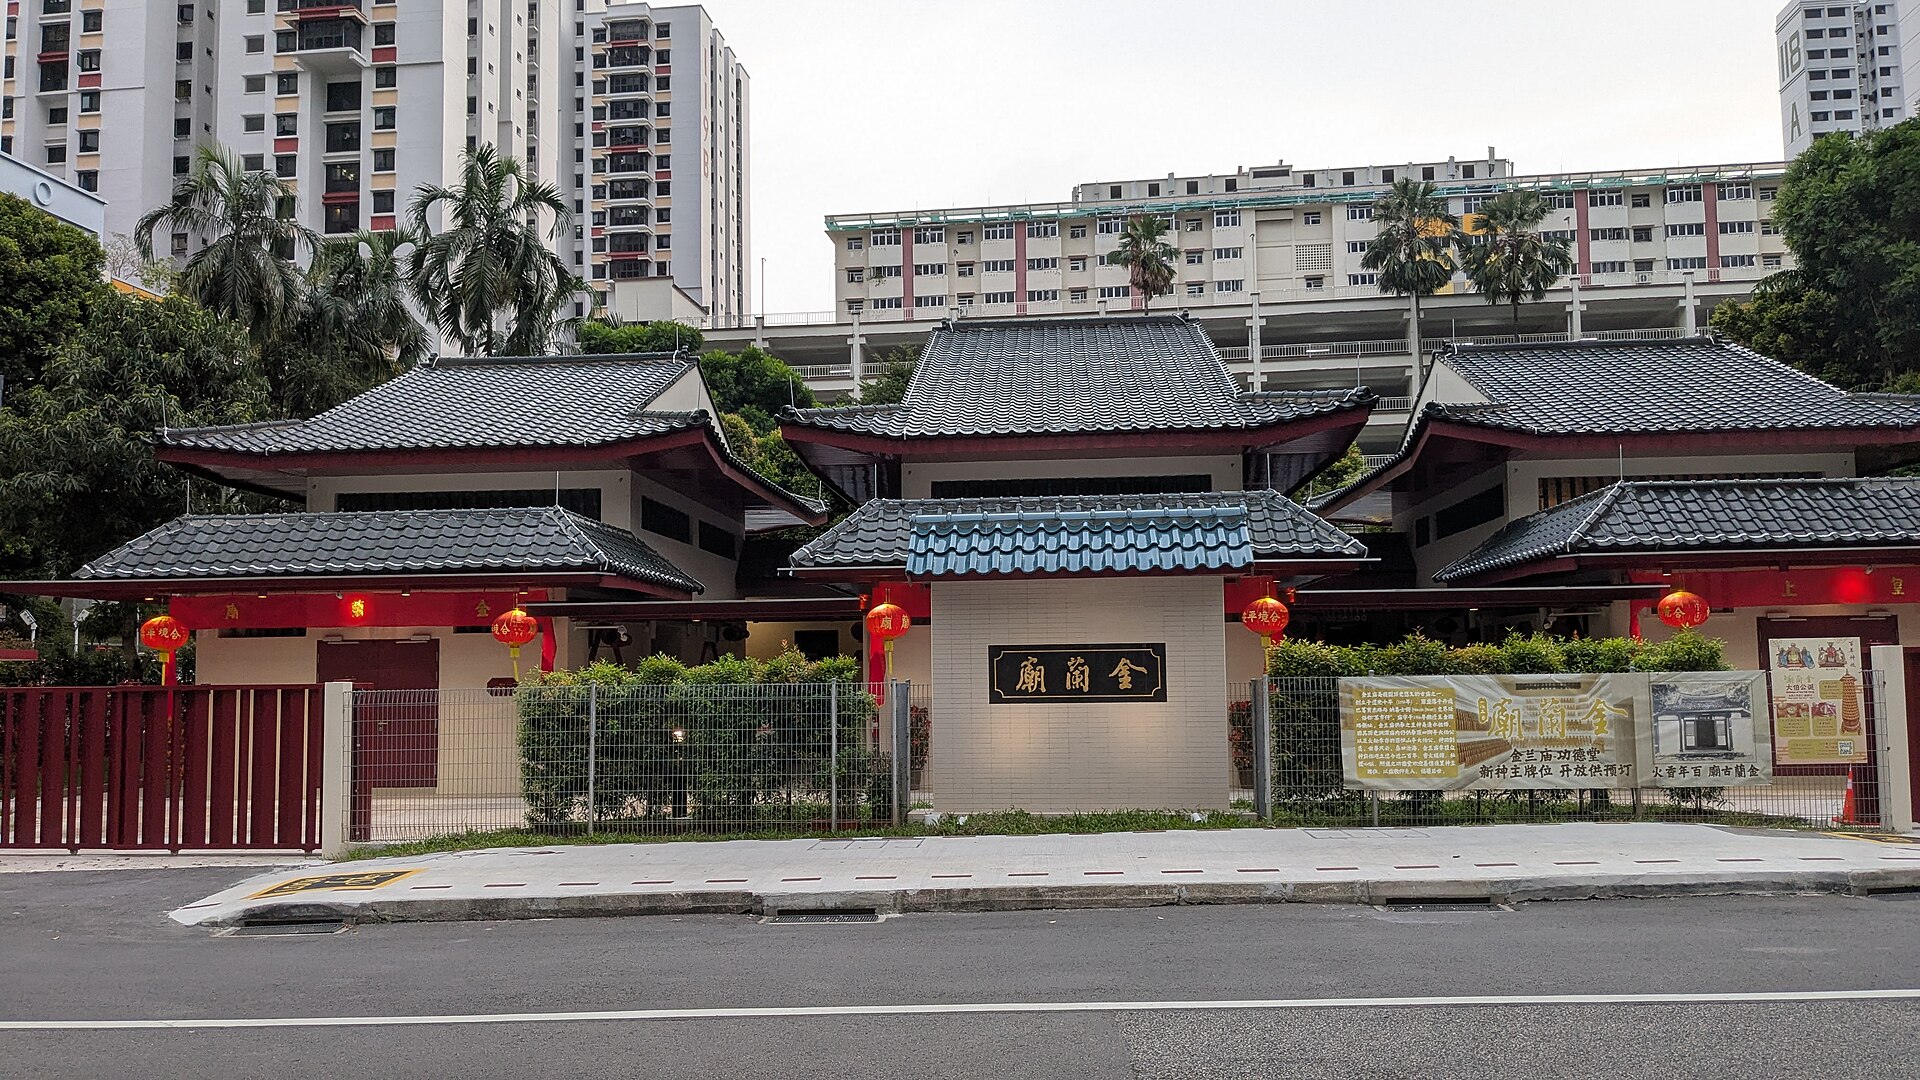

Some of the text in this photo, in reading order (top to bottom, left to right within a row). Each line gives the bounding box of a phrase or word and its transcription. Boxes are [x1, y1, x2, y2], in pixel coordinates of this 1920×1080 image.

[1779, 30, 1802, 83] 118
[1790, 101, 1802, 143] A
[1016, 656, 1148, 693] 金蘭廟
[1488, 697, 1629, 740] 金蘭廟
[1479, 763, 1633, 779] 新神主牌位 开放供预订
